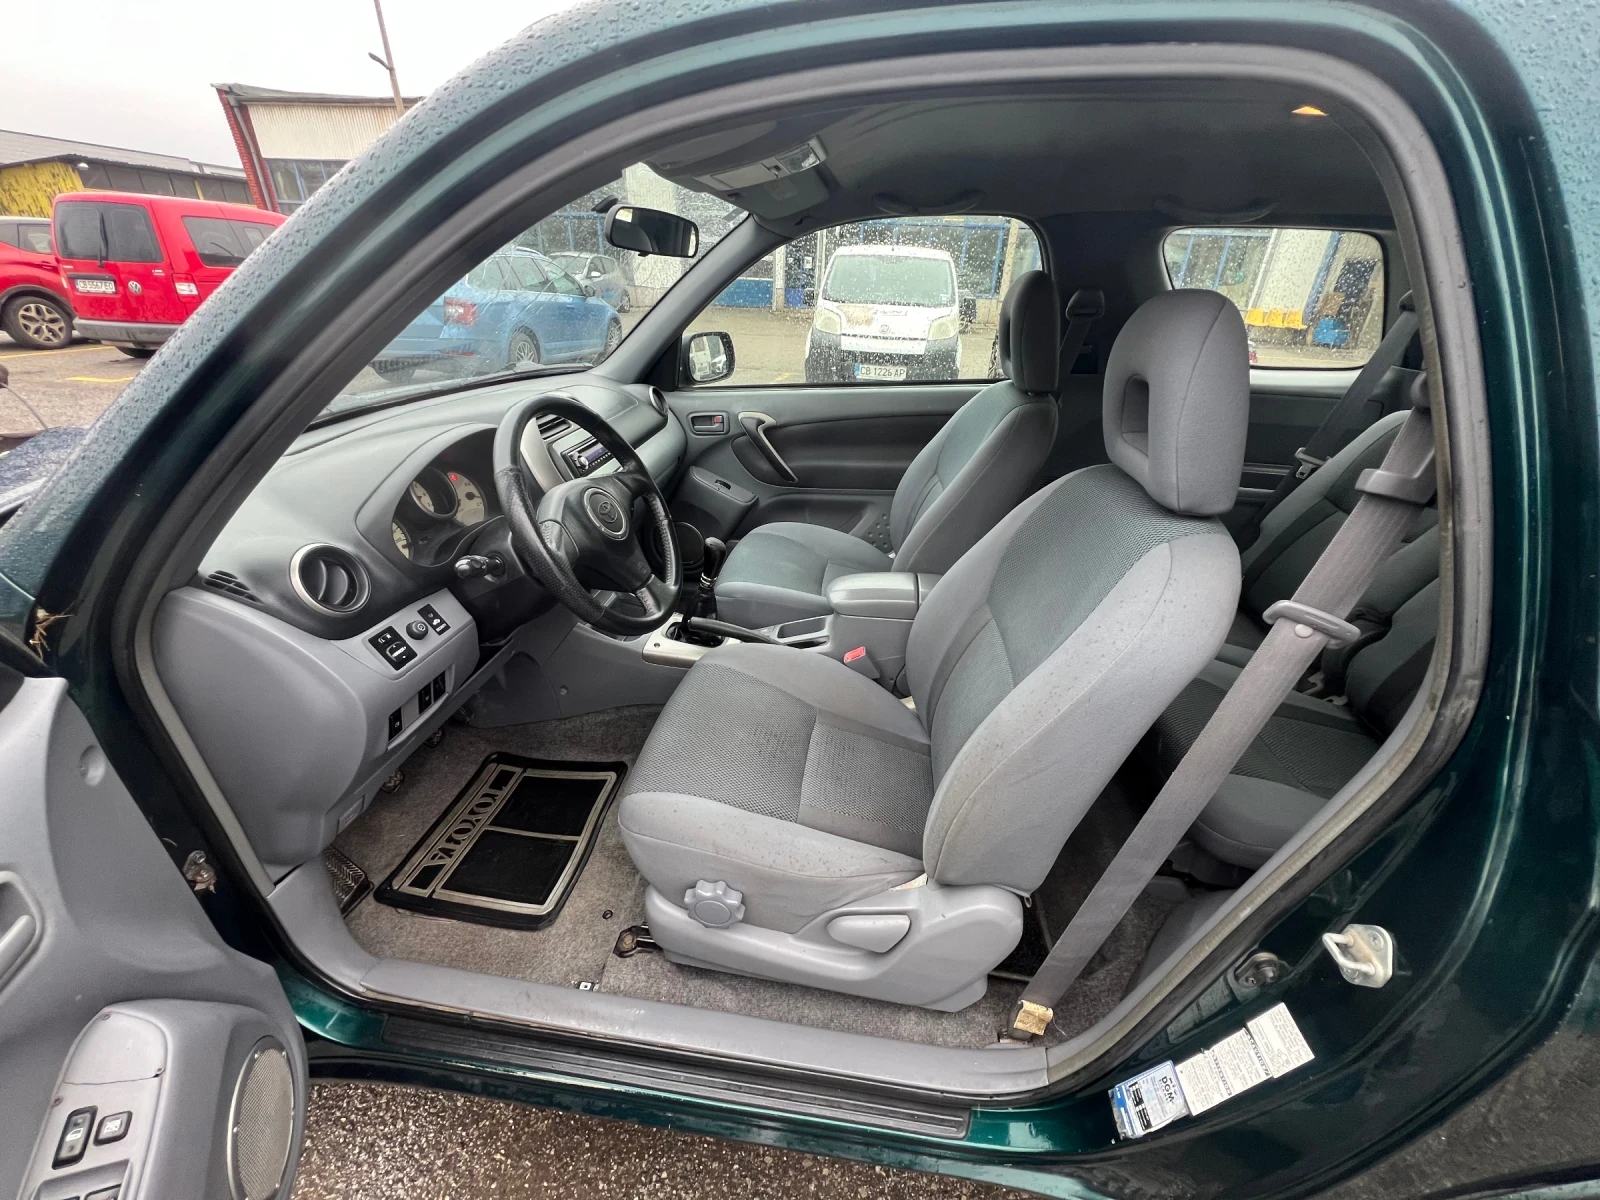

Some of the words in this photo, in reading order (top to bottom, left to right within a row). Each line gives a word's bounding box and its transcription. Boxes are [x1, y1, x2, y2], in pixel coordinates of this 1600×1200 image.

[79, 280, 88, 289] CB
[89, 280, 103, 290] 5567
[860, 366, 871, 376] CB
[874, 367, 892, 377] 1226
[893, 369, 906, 377] AP
[422, 786, 506, 867] TOYOTA
[1161, 1075, 1175, 1105] DGM
